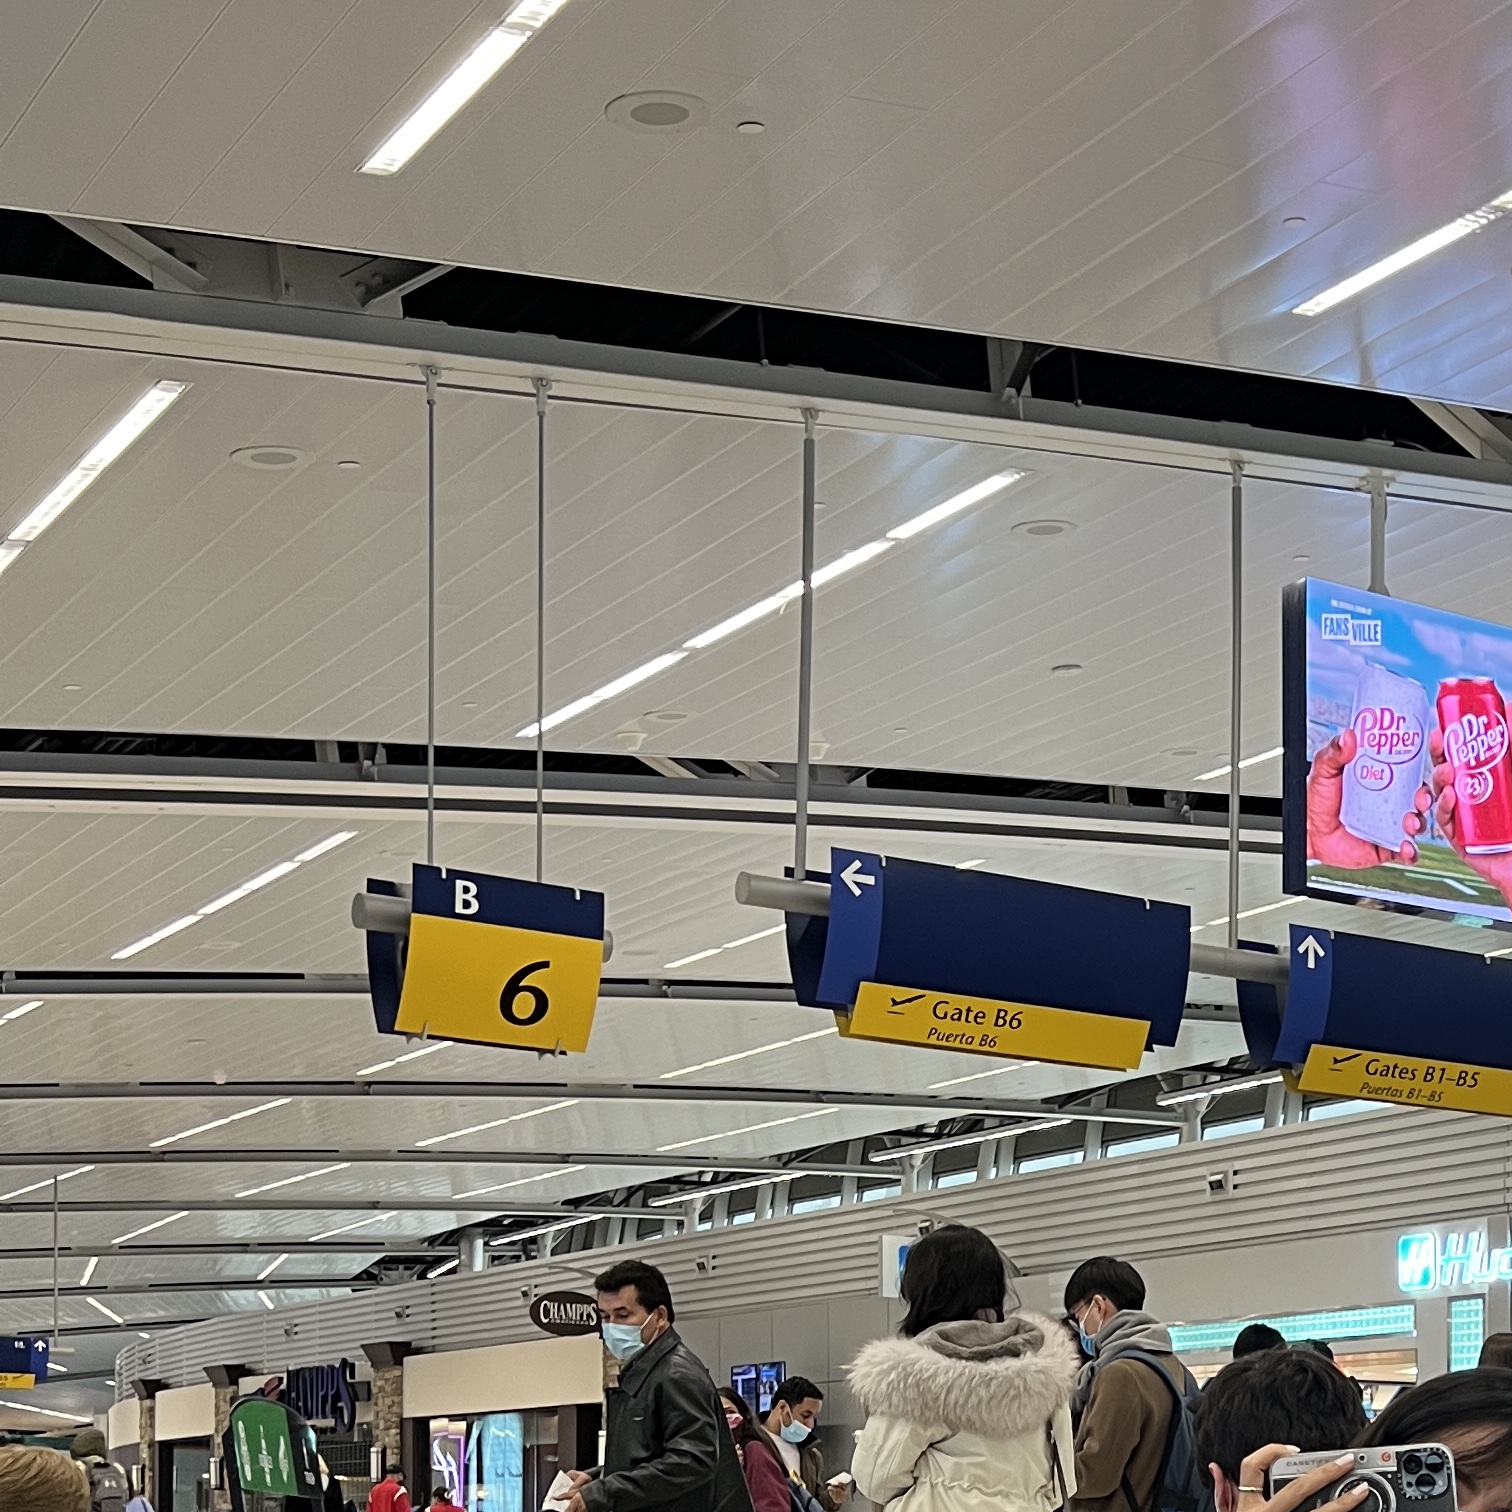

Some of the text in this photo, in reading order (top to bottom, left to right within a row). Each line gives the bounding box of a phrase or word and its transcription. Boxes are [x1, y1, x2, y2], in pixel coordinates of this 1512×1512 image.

[1354, 708, 1420, 755] Pepper
[1378, 707, 1406, 732] Dr
[1461, 713, 1488, 742] Dr
[1445, 722, 1504, 768] Pepper
[1359, 764, 1385, 781] Diet
[454, 878, 480, 915] B
[499, 960, 551, 1026] 6
[932, 1000, 1024, 1031] Gate B6
[927, 1027, 999, 1049] Puerta B6
[1365, 1058, 1418, 1082] Gates
[1359, 1081, 1404, 1099] Puertas
[540, 1300, 597, 1326] CHAMPPS
